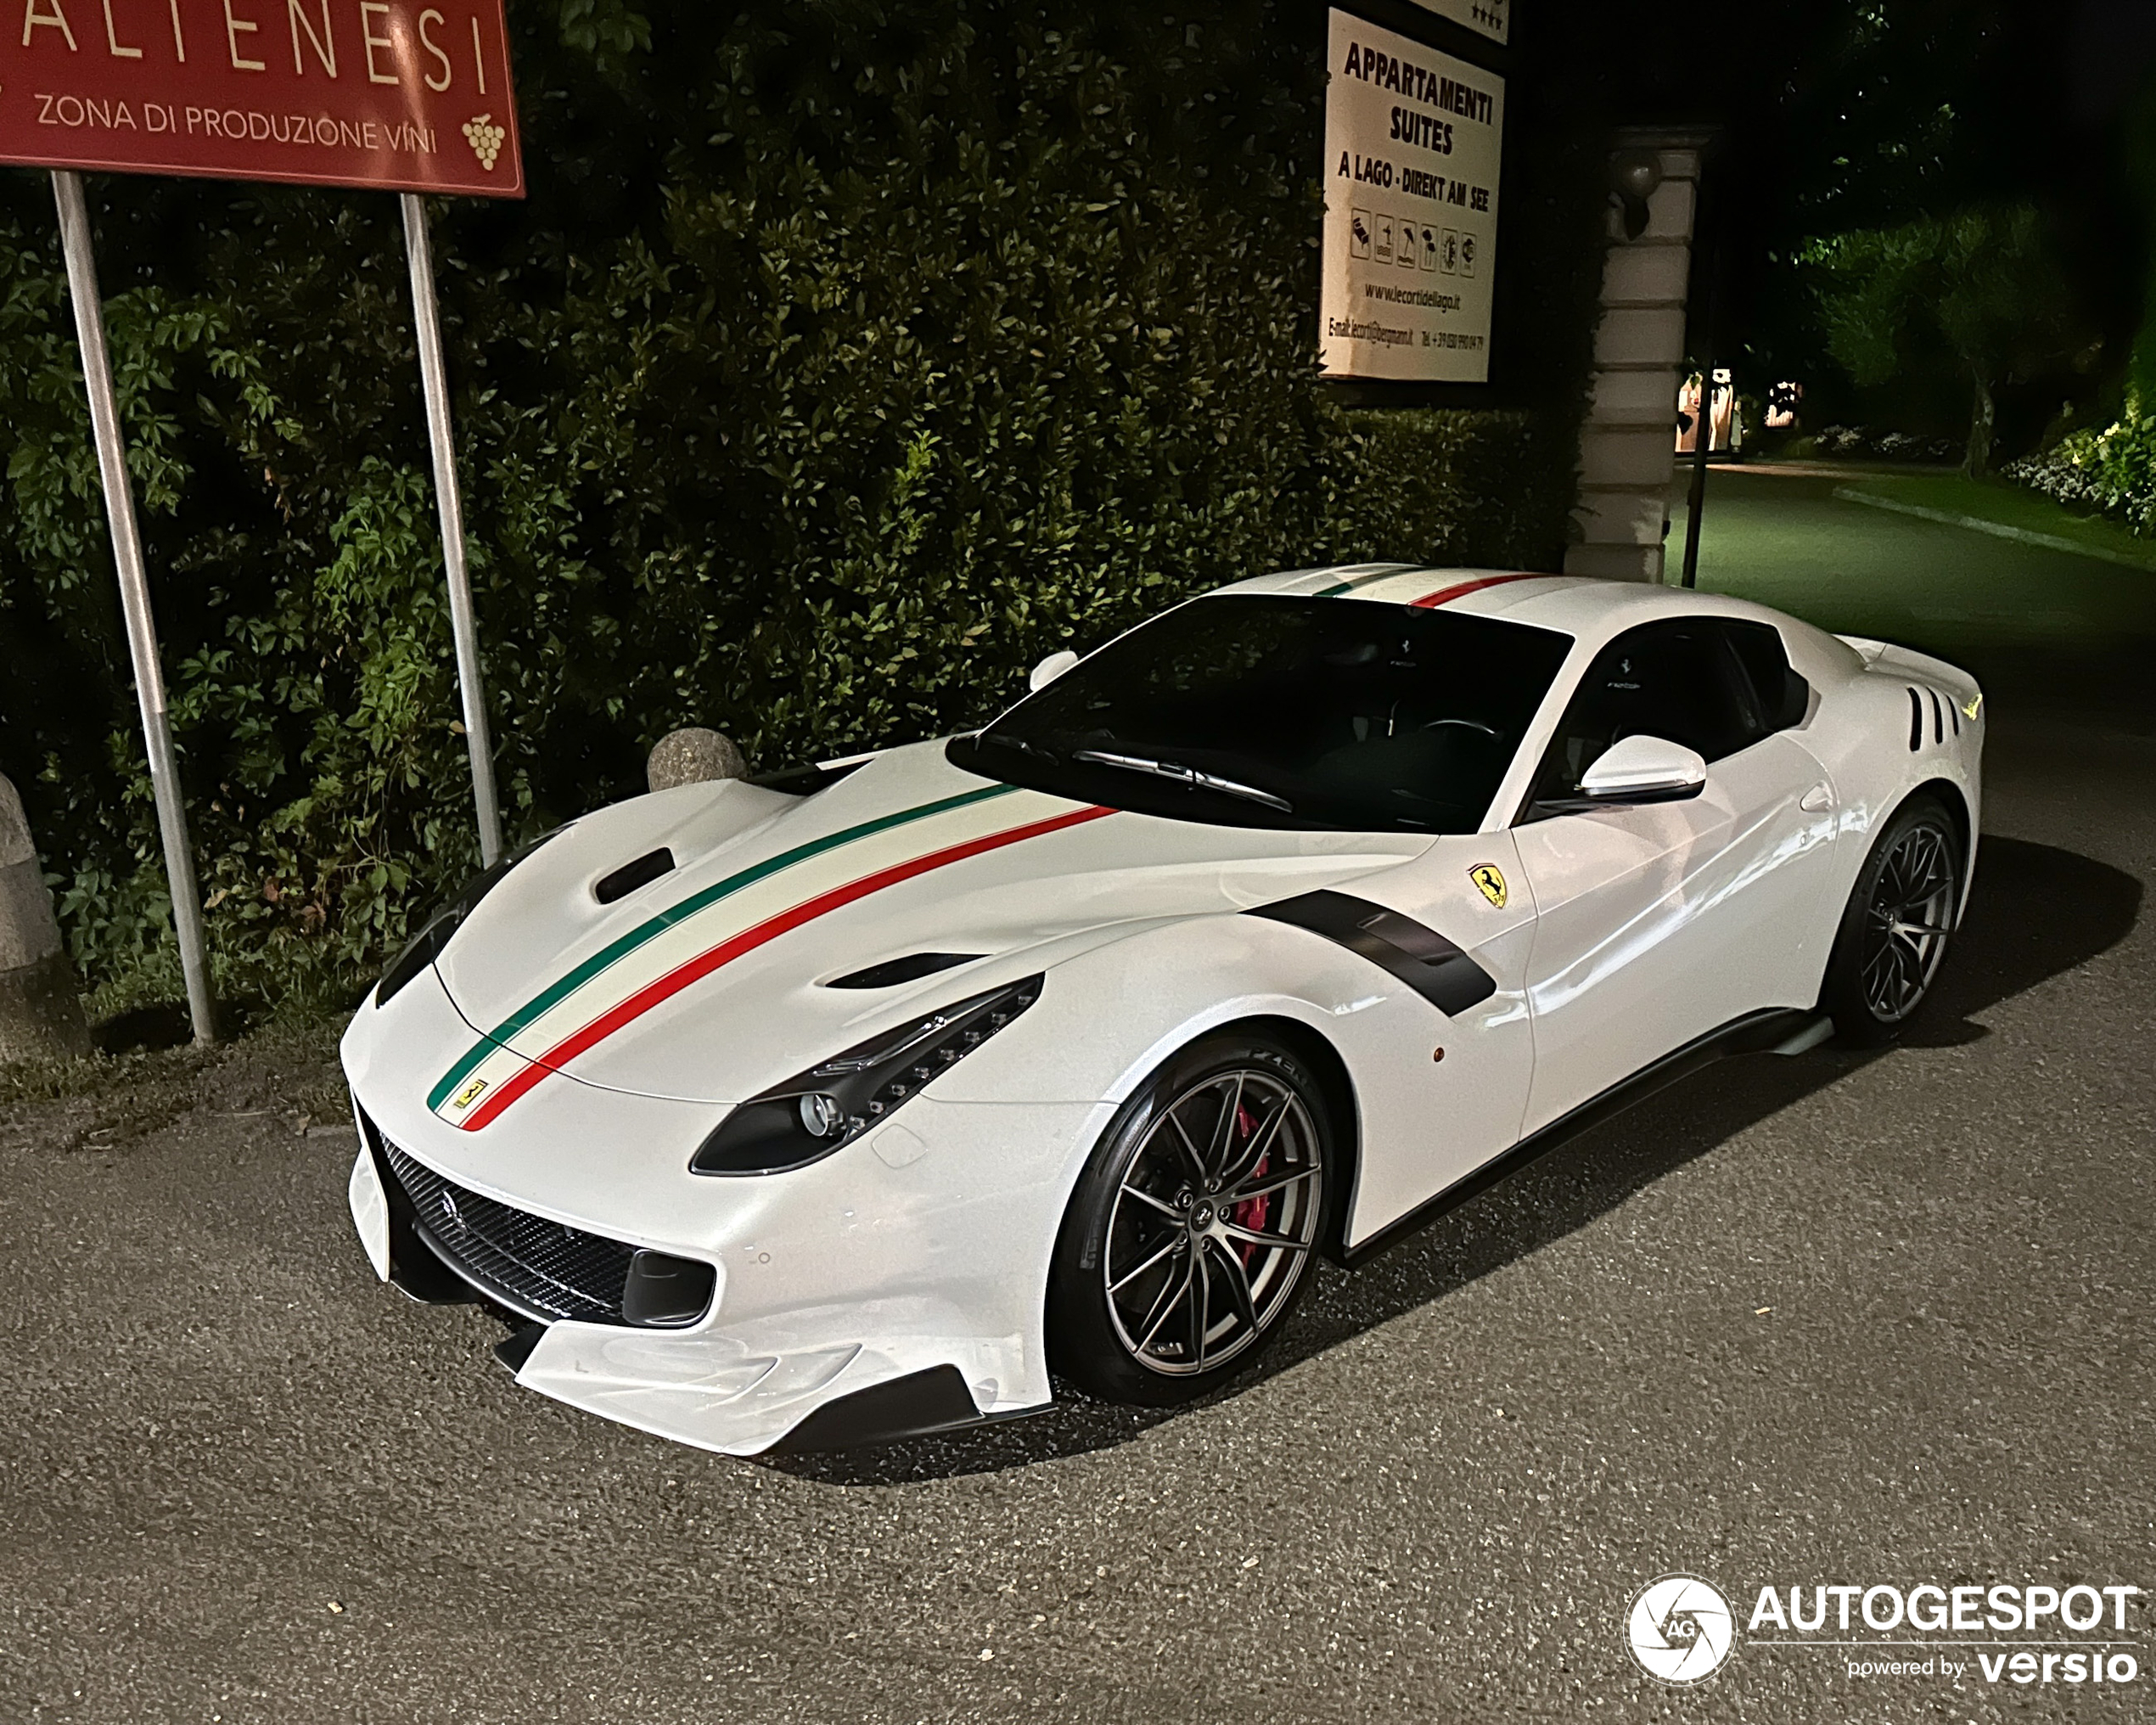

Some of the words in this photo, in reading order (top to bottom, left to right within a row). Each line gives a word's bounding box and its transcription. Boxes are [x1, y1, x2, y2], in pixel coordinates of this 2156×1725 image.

[1344, 42, 1493, 126] APPARTAMENTI
[34, 93, 138, 131] ZONA
[144, 103, 177, 134] DI
[186, 107, 379, 151] PRODUZIONE
[383, 125, 437, 155] VINI
[1390, 105, 1454, 155] SUITES
[1338, 151, 1350, 179] A
[1354, 155, 1393, 188] LAGO
[1401, 167, 1446, 201] DIREKT
[1447, 180, 1468, 207] AM
[1470, 186, 1490, 213] SEE
[1365, 283, 1461, 314] www.lecortidellago.it
